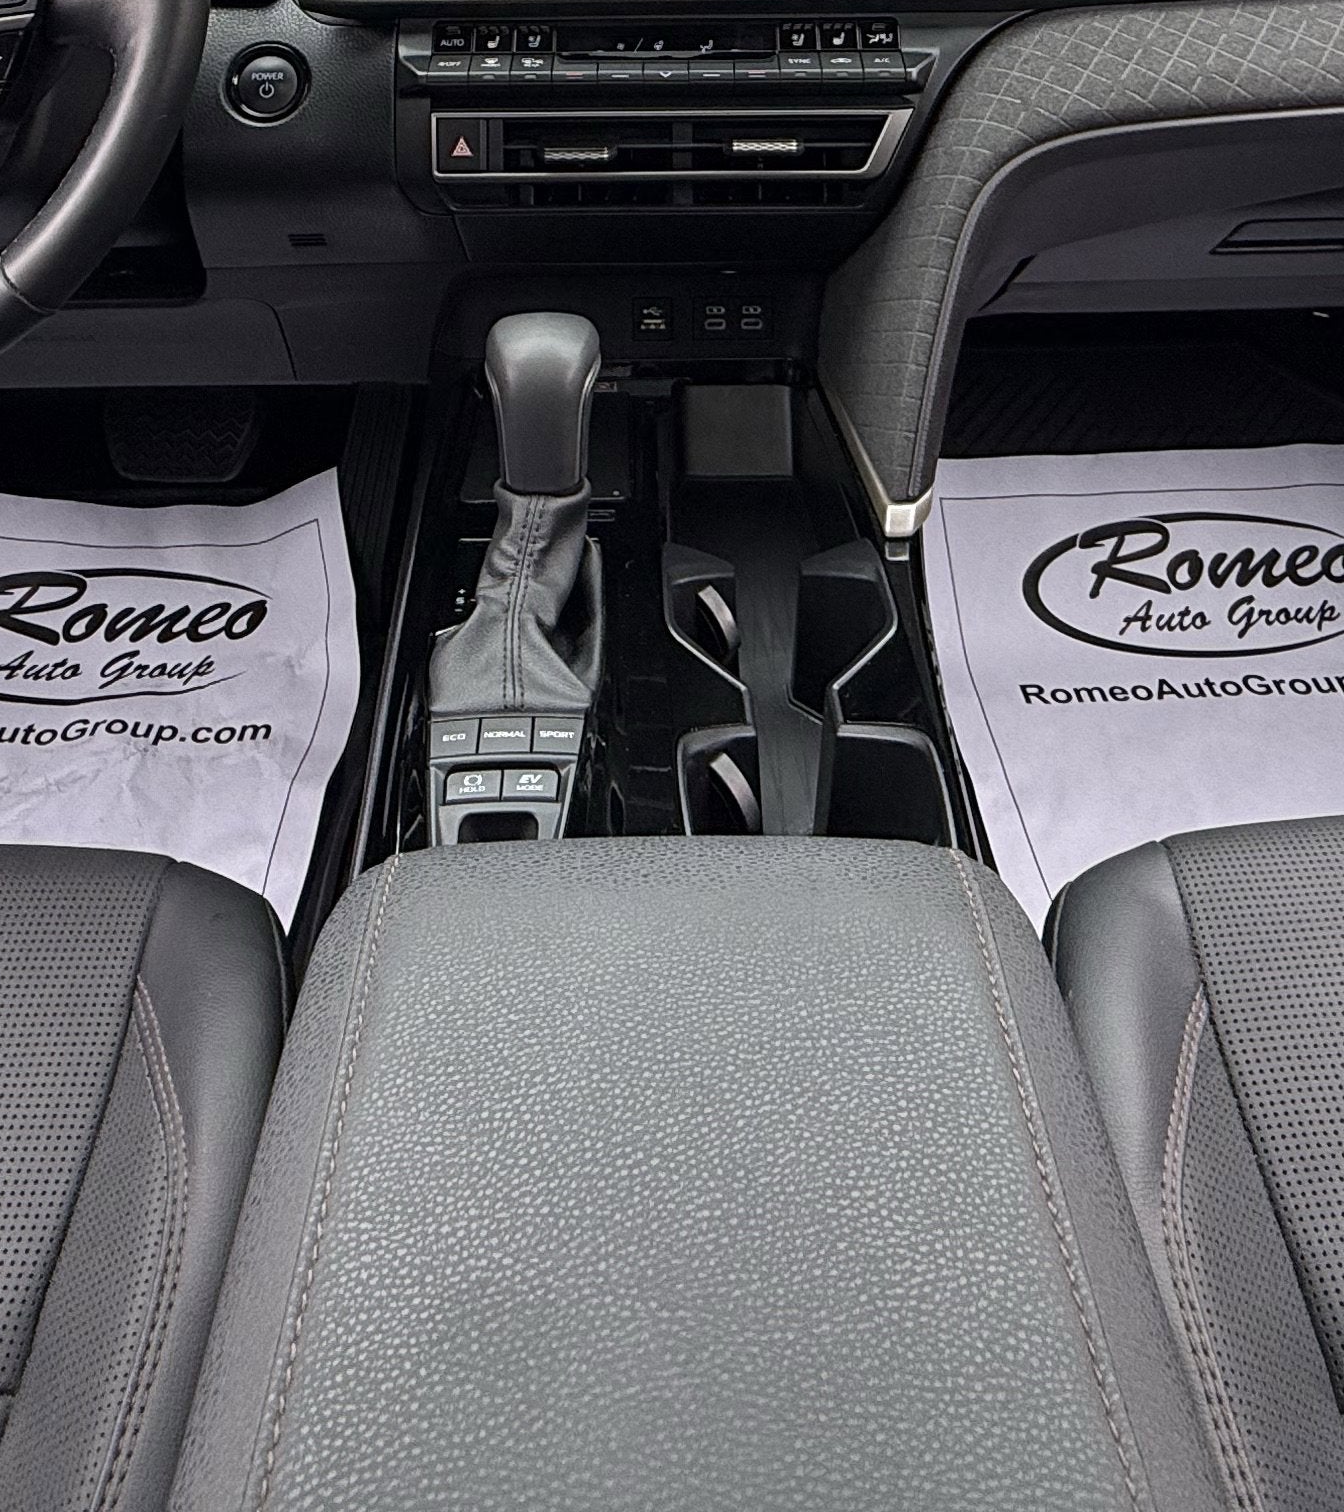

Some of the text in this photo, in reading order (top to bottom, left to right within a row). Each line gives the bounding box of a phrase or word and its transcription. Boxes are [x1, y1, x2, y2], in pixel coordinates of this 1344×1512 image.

[440, 38, 464, 47] AUTO
[251, 72, 284, 80] POWER
[1118, 594, 1342, 639] Auto Group
[97, 649, 217, 690] Group
[442, 733, 466, 742] ECO
[484, 730, 526, 738] NORMAL
[539, 730, 575, 739] SPORT
[519, 774, 542, 784] EV
[459, 785, 486, 794] HOLD
